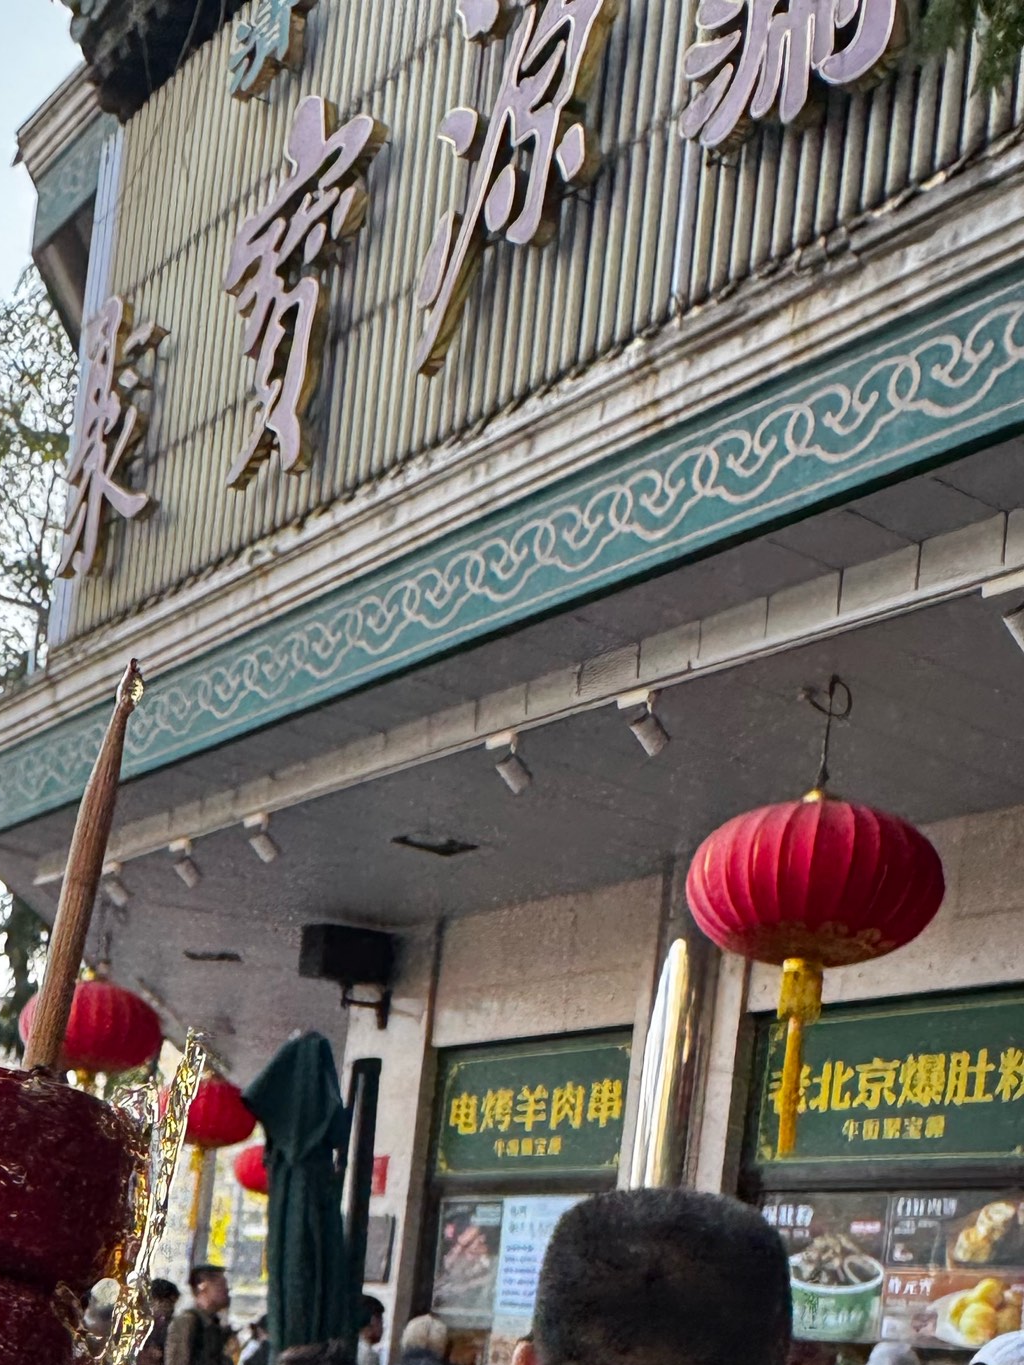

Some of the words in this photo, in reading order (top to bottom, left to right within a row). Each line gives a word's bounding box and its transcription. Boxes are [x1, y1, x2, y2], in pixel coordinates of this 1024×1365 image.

[449, 1078, 622, 1134] 电烤羊肉串
